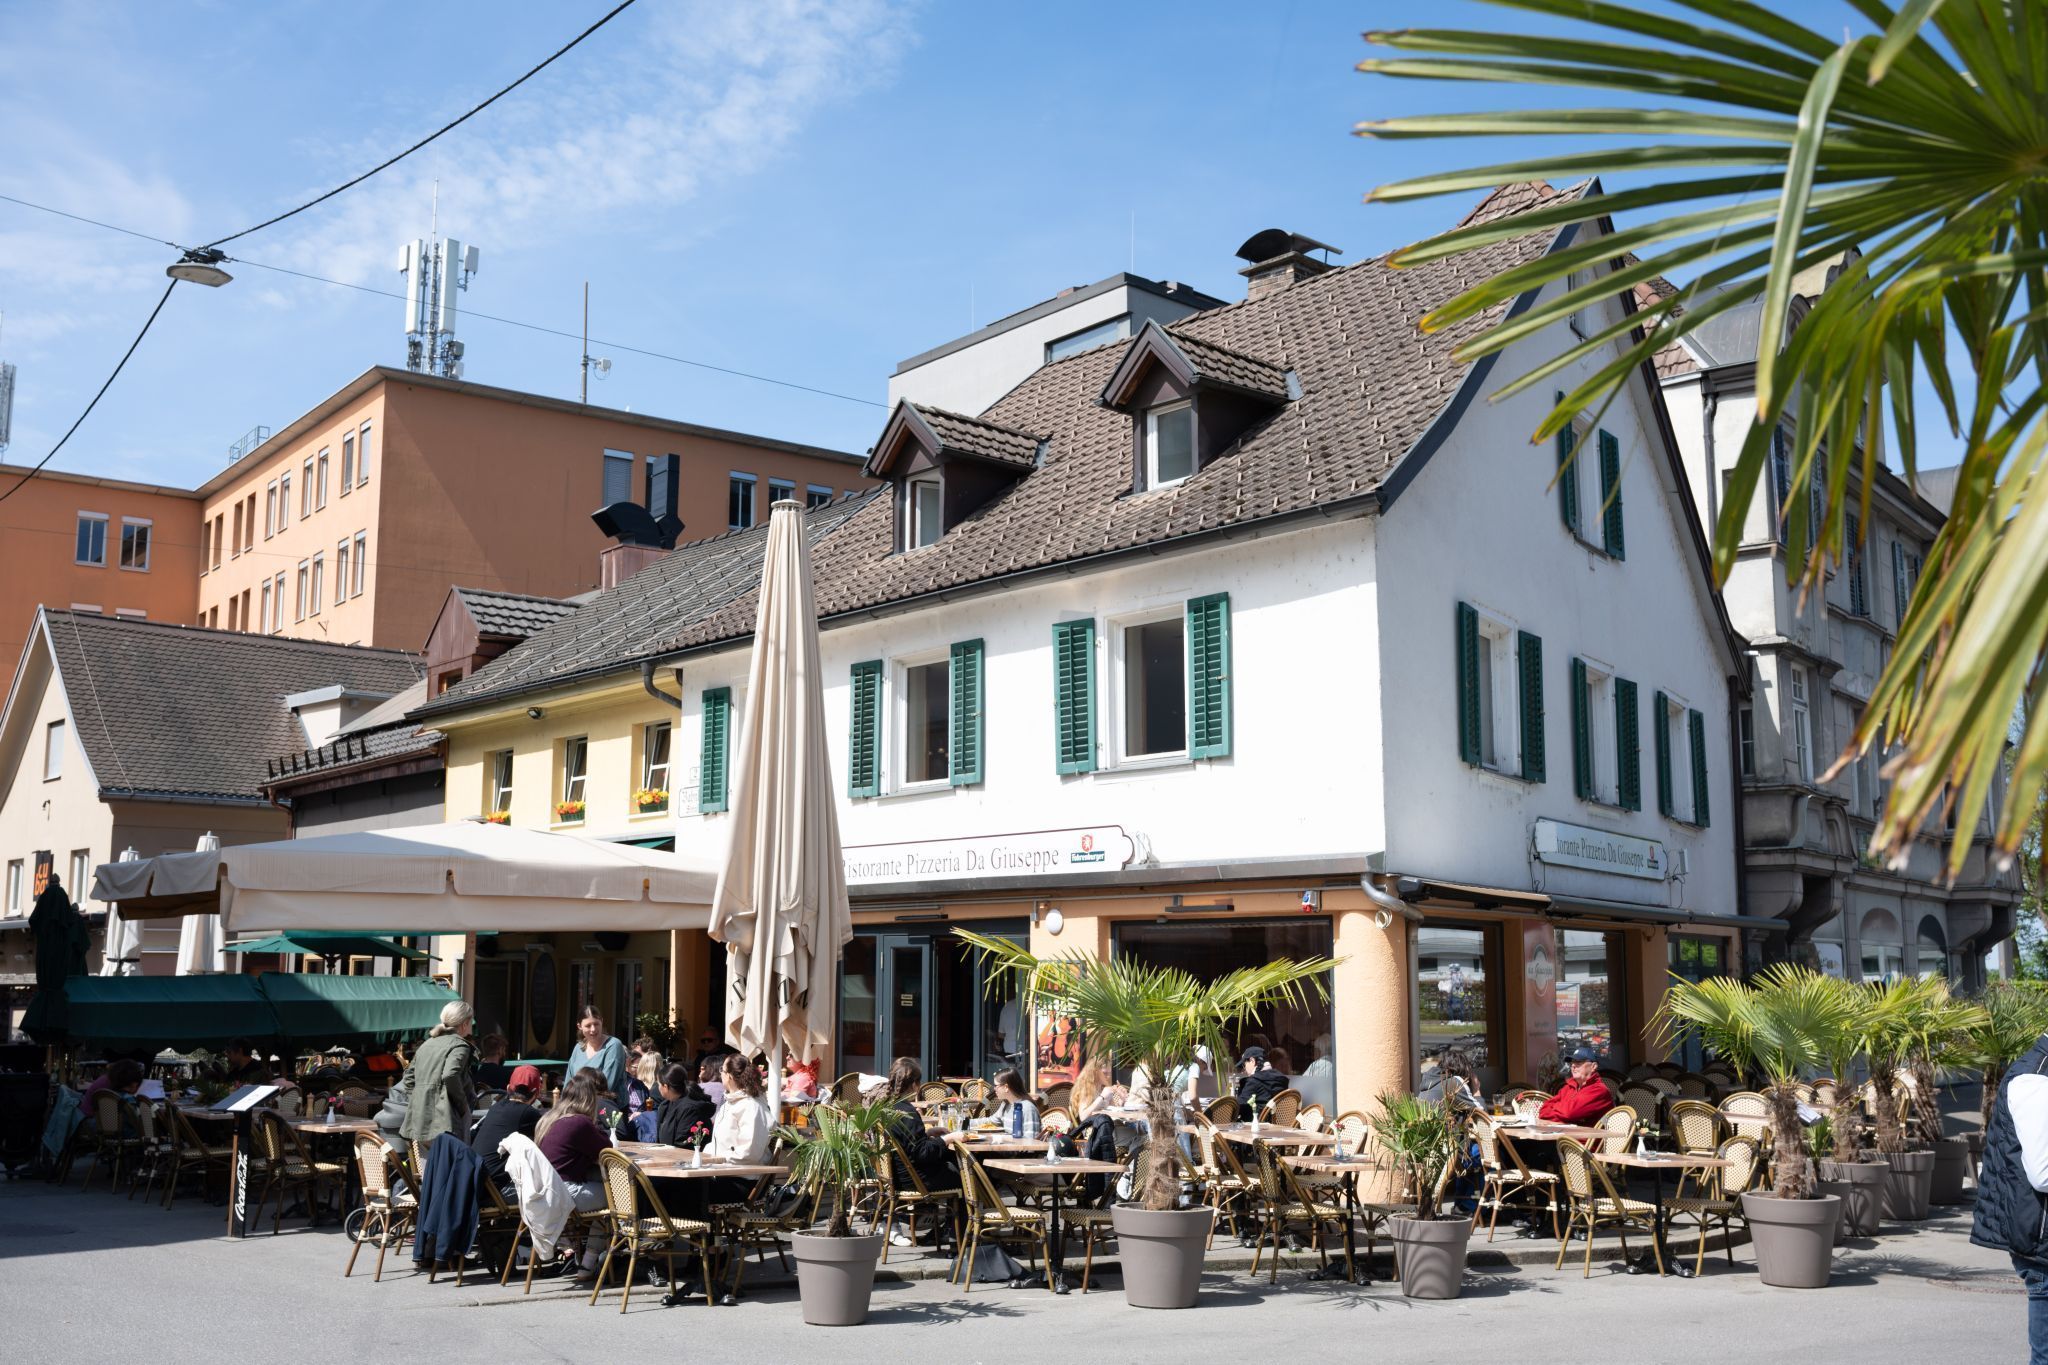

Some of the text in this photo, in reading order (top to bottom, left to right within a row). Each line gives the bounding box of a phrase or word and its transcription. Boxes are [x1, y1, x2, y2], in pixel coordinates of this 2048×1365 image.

[907, 851, 960, 875] Pizzeria
[967, 850, 985, 871] Da
[991, 847, 1059, 874] Giuseppe
[1581, 838, 1606, 862] Pizzeria
[1608, 843, 1617, 863] Da
[1618, 846, 1644, 872] Giuseppe
